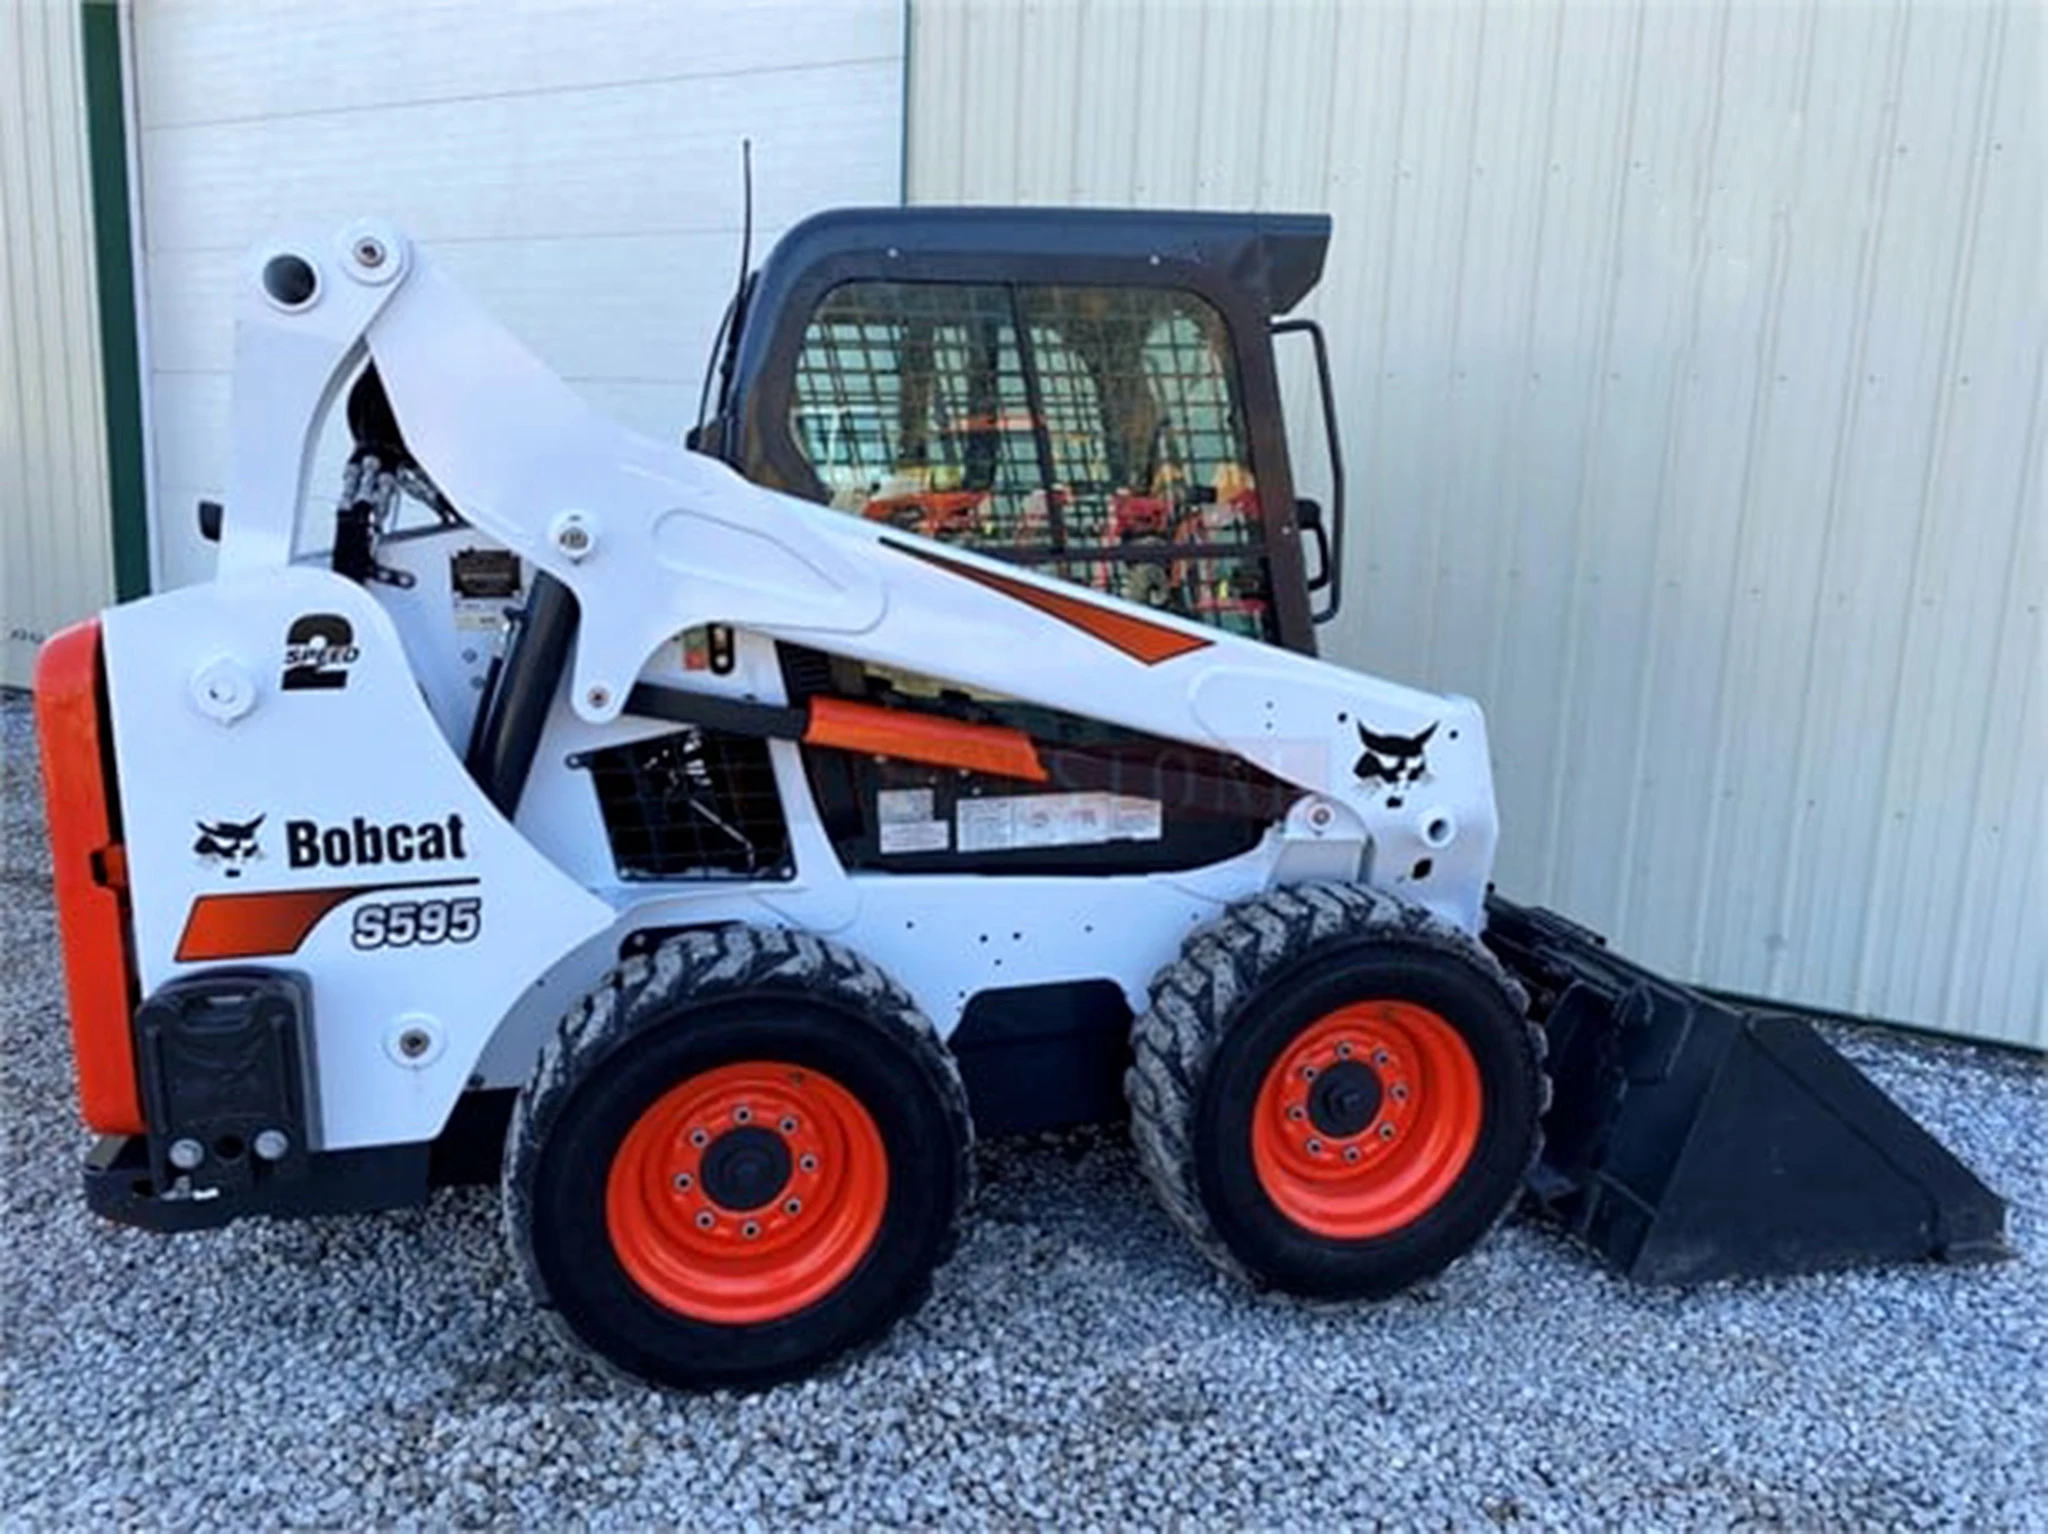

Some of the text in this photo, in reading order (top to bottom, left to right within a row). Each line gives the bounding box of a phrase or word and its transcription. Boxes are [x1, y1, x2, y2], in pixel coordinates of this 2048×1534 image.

[281, 613, 354, 690] 2
[284, 644, 361, 666] SPEED
[285, 813, 466, 869] Bobcat
[352, 897, 482, 950] S595
